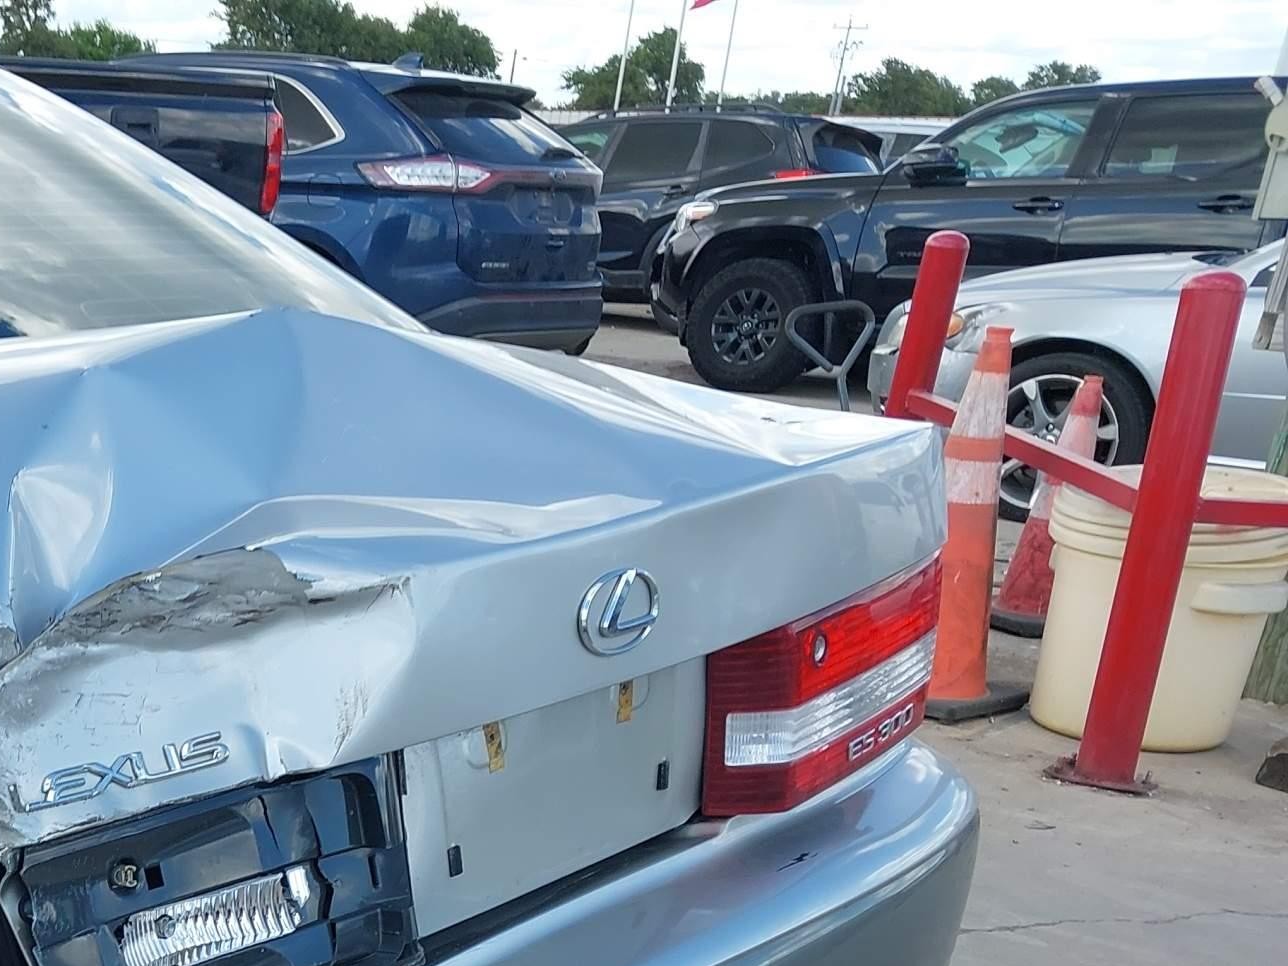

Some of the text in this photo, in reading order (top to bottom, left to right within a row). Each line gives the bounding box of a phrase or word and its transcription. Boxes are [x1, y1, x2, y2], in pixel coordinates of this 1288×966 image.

[848, 703, 914, 761] ES 300
[8, 731, 230, 813] LEXUS
